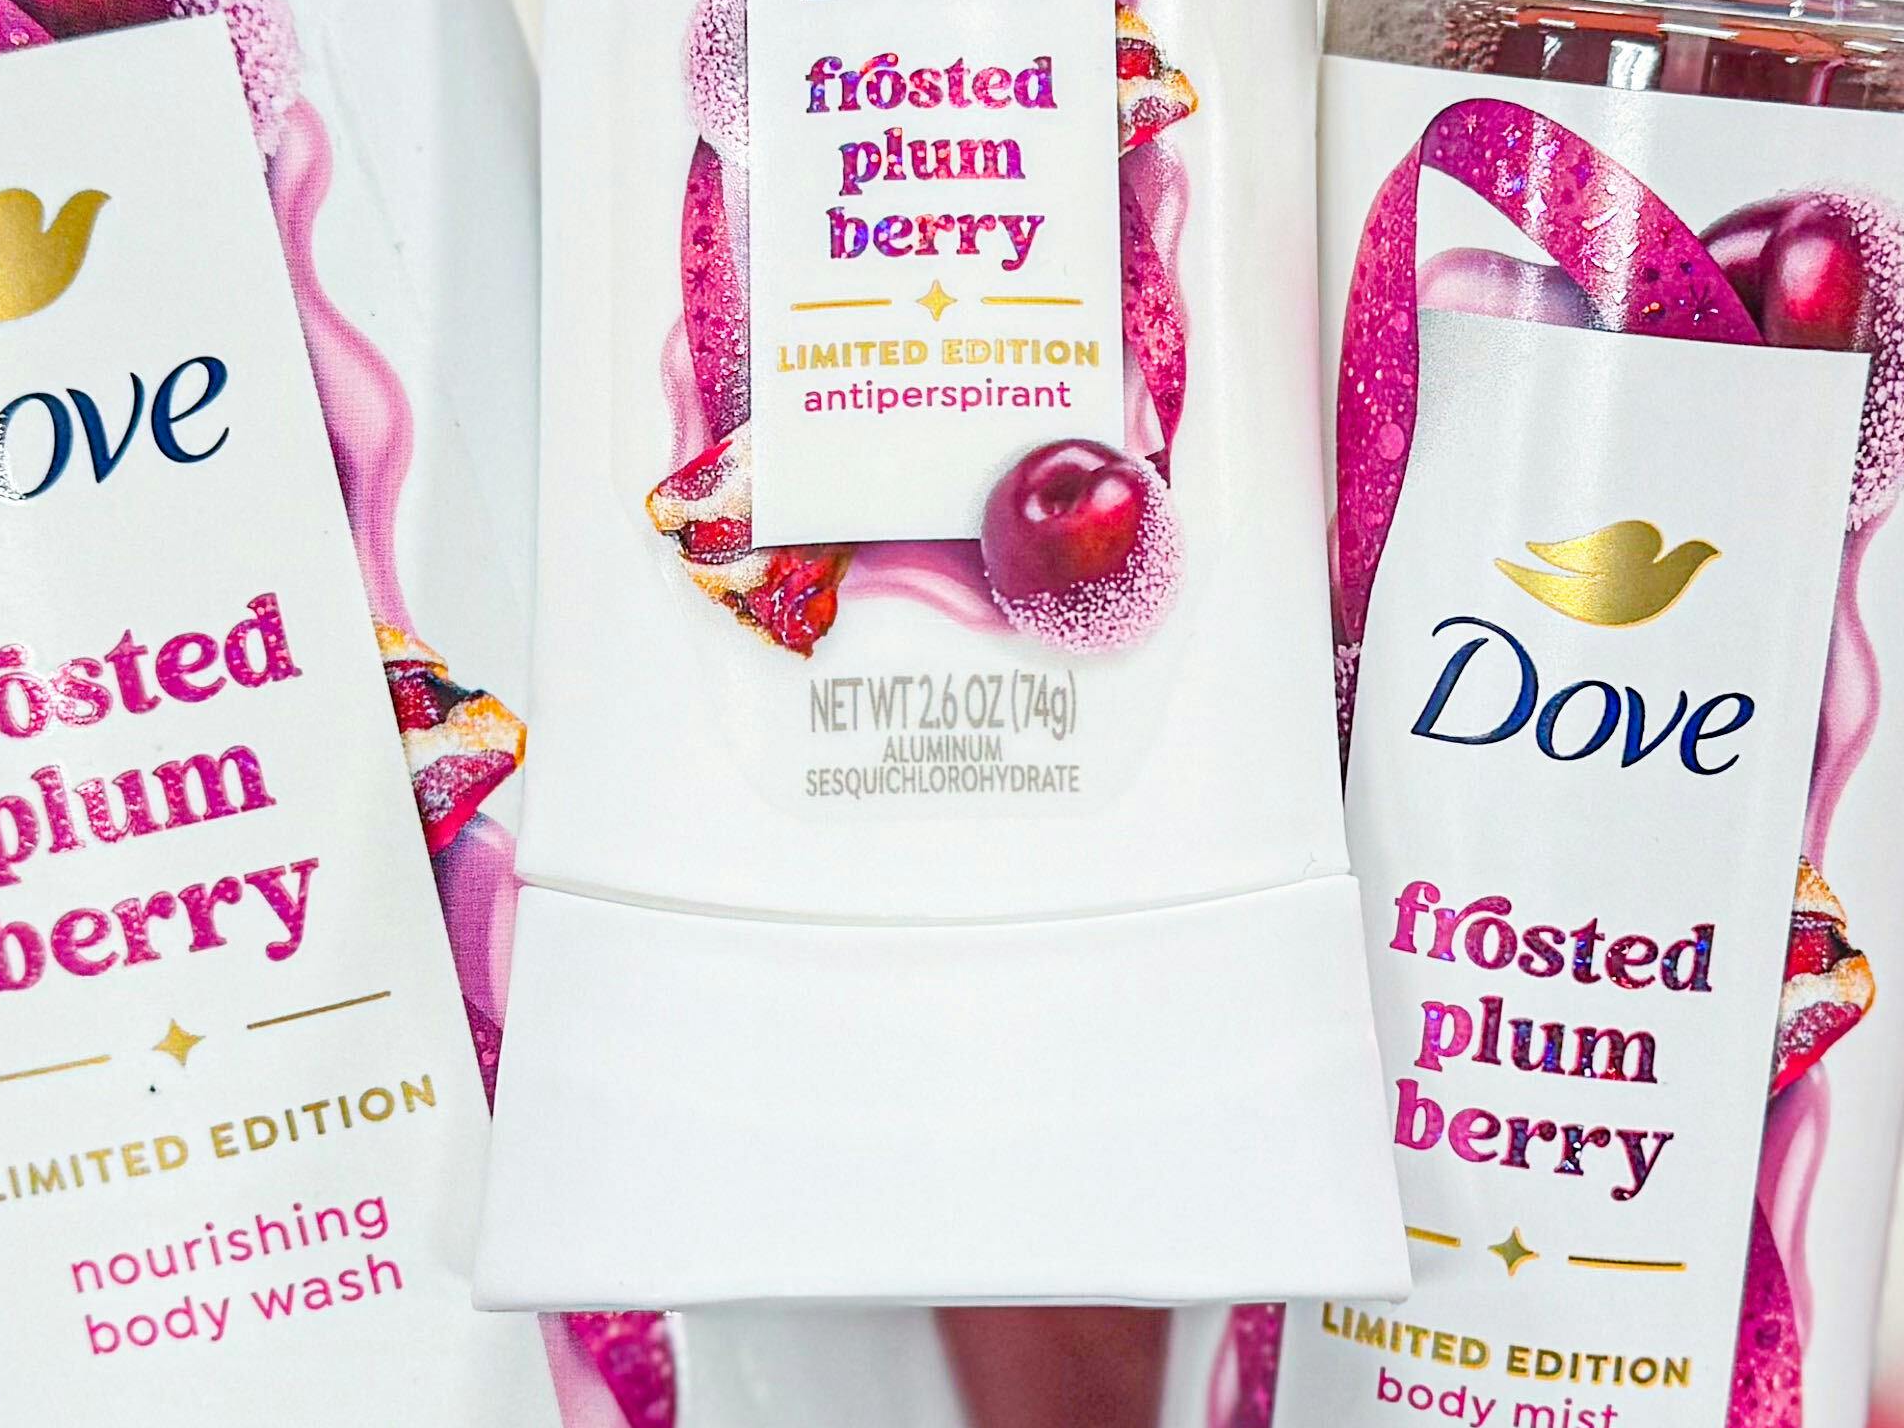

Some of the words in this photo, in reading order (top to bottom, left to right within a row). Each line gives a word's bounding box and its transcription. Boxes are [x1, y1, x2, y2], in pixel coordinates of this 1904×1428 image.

[805, 52, 1059, 114] frosted
[837, 127, 1026, 197] plum
[825, 206, 1046, 272] berry
[777, 339, 929, 373] LIMITED
[941, 338, 1100, 368] EDITION
[804, 378, 1073, 414] antiperspirant
[809, 677, 864, 733] NET
[866, 675, 914, 729] WT
[917, 673, 958, 730] 2.6
[964, 673, 1005, 729] OZ
[1010, 668, 1077, 741] (74g)
[1410, 615, 1756, 777] Dove
[805, 764, 1081, 799] SESQUICHLOROHYDRATE
[882, 734, 1004, 764] ALUMINUM
[1389, 880, 1716, 992] frosted
[1414, 995, 1658, 1084] plum
[209, 1074, 437, 1159] EDITION
[1394, 1078, 1675, 1202] berry
[71, 1196, 390, 1294] nourishing
[85, 1295, 230, 1356] body
[251, 1254, 403, 1321] wash
[1321, 1301, 1491, 1371] LIMITED
[1506, 1344, 1693, 1388] EDITION
[1376, 1367, 1497, 1428] body
